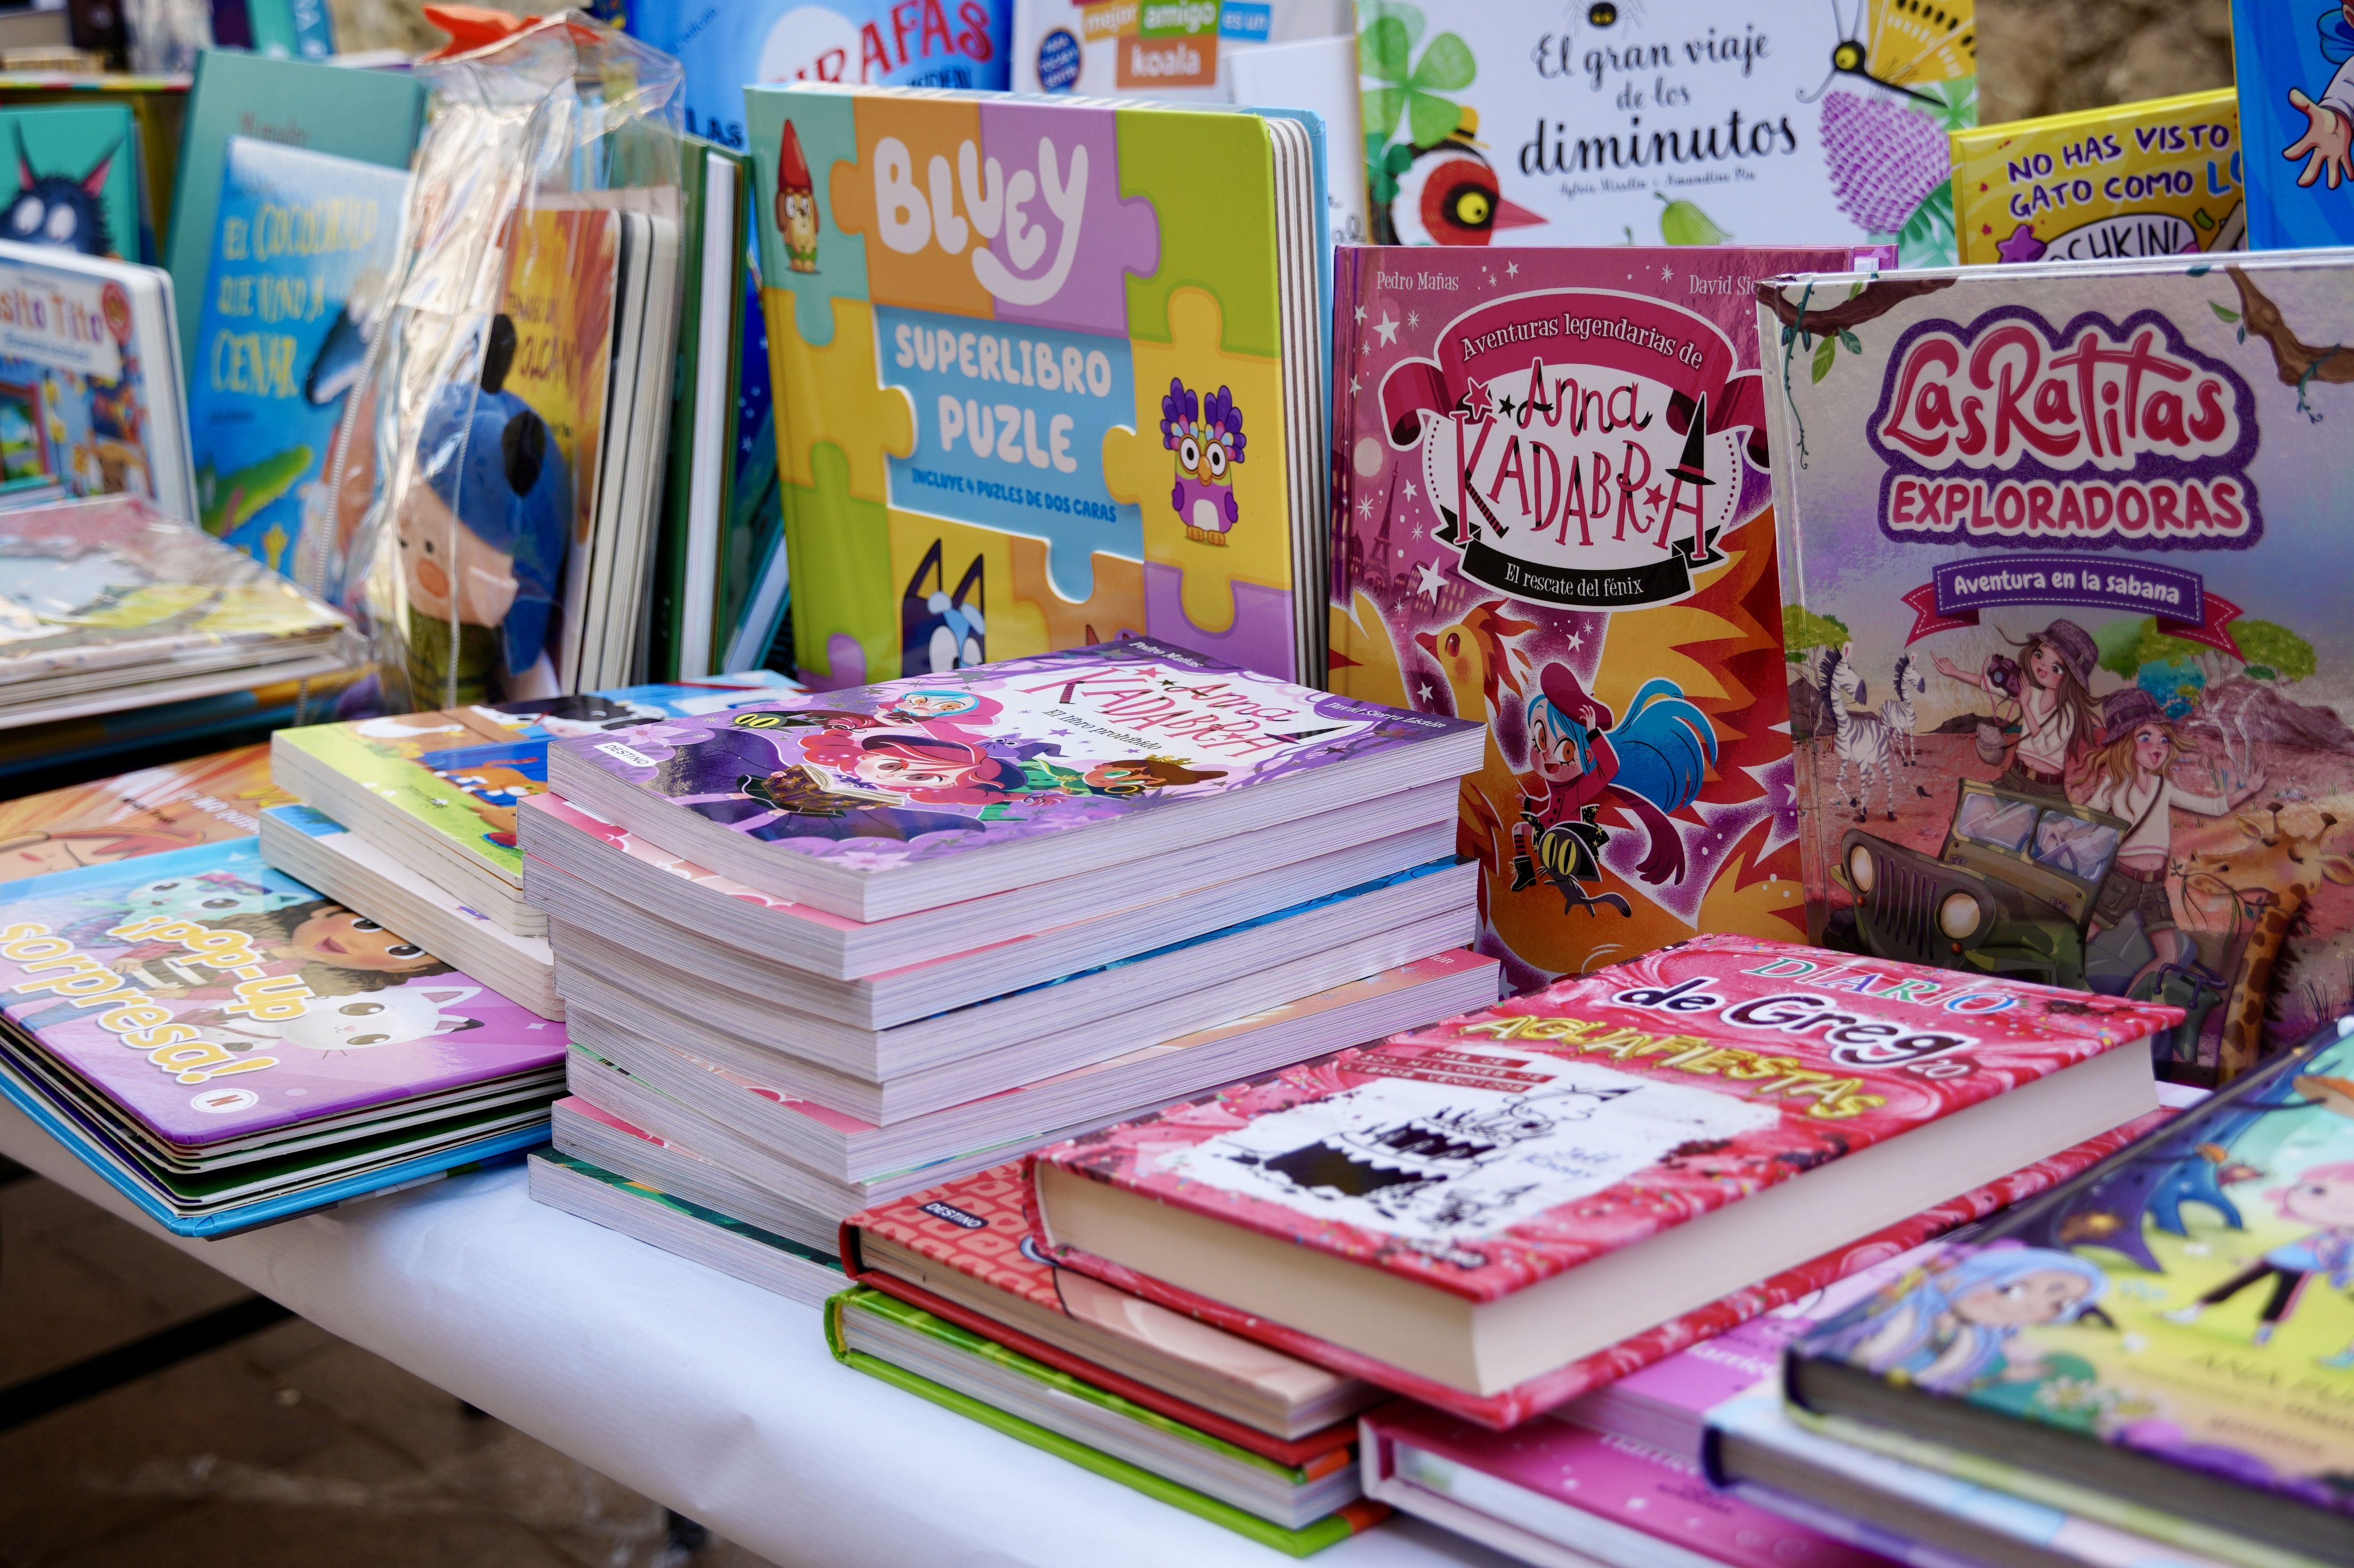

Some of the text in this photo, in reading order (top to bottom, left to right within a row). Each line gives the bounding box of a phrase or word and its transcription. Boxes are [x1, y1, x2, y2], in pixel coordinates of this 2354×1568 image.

[769, 0, 993, 85] RAFAS
[1088, 4, 1138, 31] mejor
[1143, 2, 1218, 33] amigo
[1223, 12, 1268, 30] es un
[1131, 44, 1202, 77] koala
[1531, 23, 1770, 92] El gran viaje
[1615, 75, 1691, 111] de los
[1518, 107, 1796, 176] diminutos
[2007, 124, 2230, 184] NO HAS VISTO
[2010, 179, 2093, 219] GATO
[2103, 170, 2193, 199] COMO
[873, 136, 1089, 306] BLUEY
[1377, 271, 1459, 291] Pedro Mañas
[1689, 274, 1757, 296] David Sie
[0, 288, 105, 346] sito Tito
[1461, 313, 1703, 370] Aventuras legendarias de
[895, 323, 1113, 398] SUPERLIBRO
[1516, 357, 1654, 437] Anna
[1883, 325, 2227, 458] Las Ratitas
[938, 395, 1078, 474] PUZLE
[912, 467, 965, 493] INCLUYE
[977, 480, 1025, 505] PUZLES
[1026, 489, 1044, 509] DE
[1045, 492, 1072, 514] DOS
[1074, 498, 1117, 524] CARAS
[1449, 391, 1717, 560] KADABRA
[1891, 480, 2244, 531] EXPLORADORAS
[1505, 562, 1645, 598] El rescate del fénix
[1953, 570, 2181, 605] Aventura en la sabana
[1015, 666, 1353, 758] KADABRA
[1163, 683, 1302, 723] Anna
[1323, 702, 1447, 729] David Sierra Listón
[603, 742, 651, 766] DESTINO
[1041, 709, 1162, 750] El libro prohibido
[106, 915, 317, 1022] ¡pop-up
[1429, 955, 1455, 964] tón
[0, 922, 280, 1085] sorpresa!
[1741, 956, 2019, 1015] DIARIO
[1612, 976, 1979, 1068] de Greg
[1343, 1064, 1527, 1092] LIBROS VENDIDOS
[1361, 1054, 1546, 1082] 300 MILLONES DE
[1458, 1014, 1887, 1120] AGUAFIESTAS
[1480, 1057, 1507, 1066] DE
[924, 1201, 983, 1228] DESTINO
